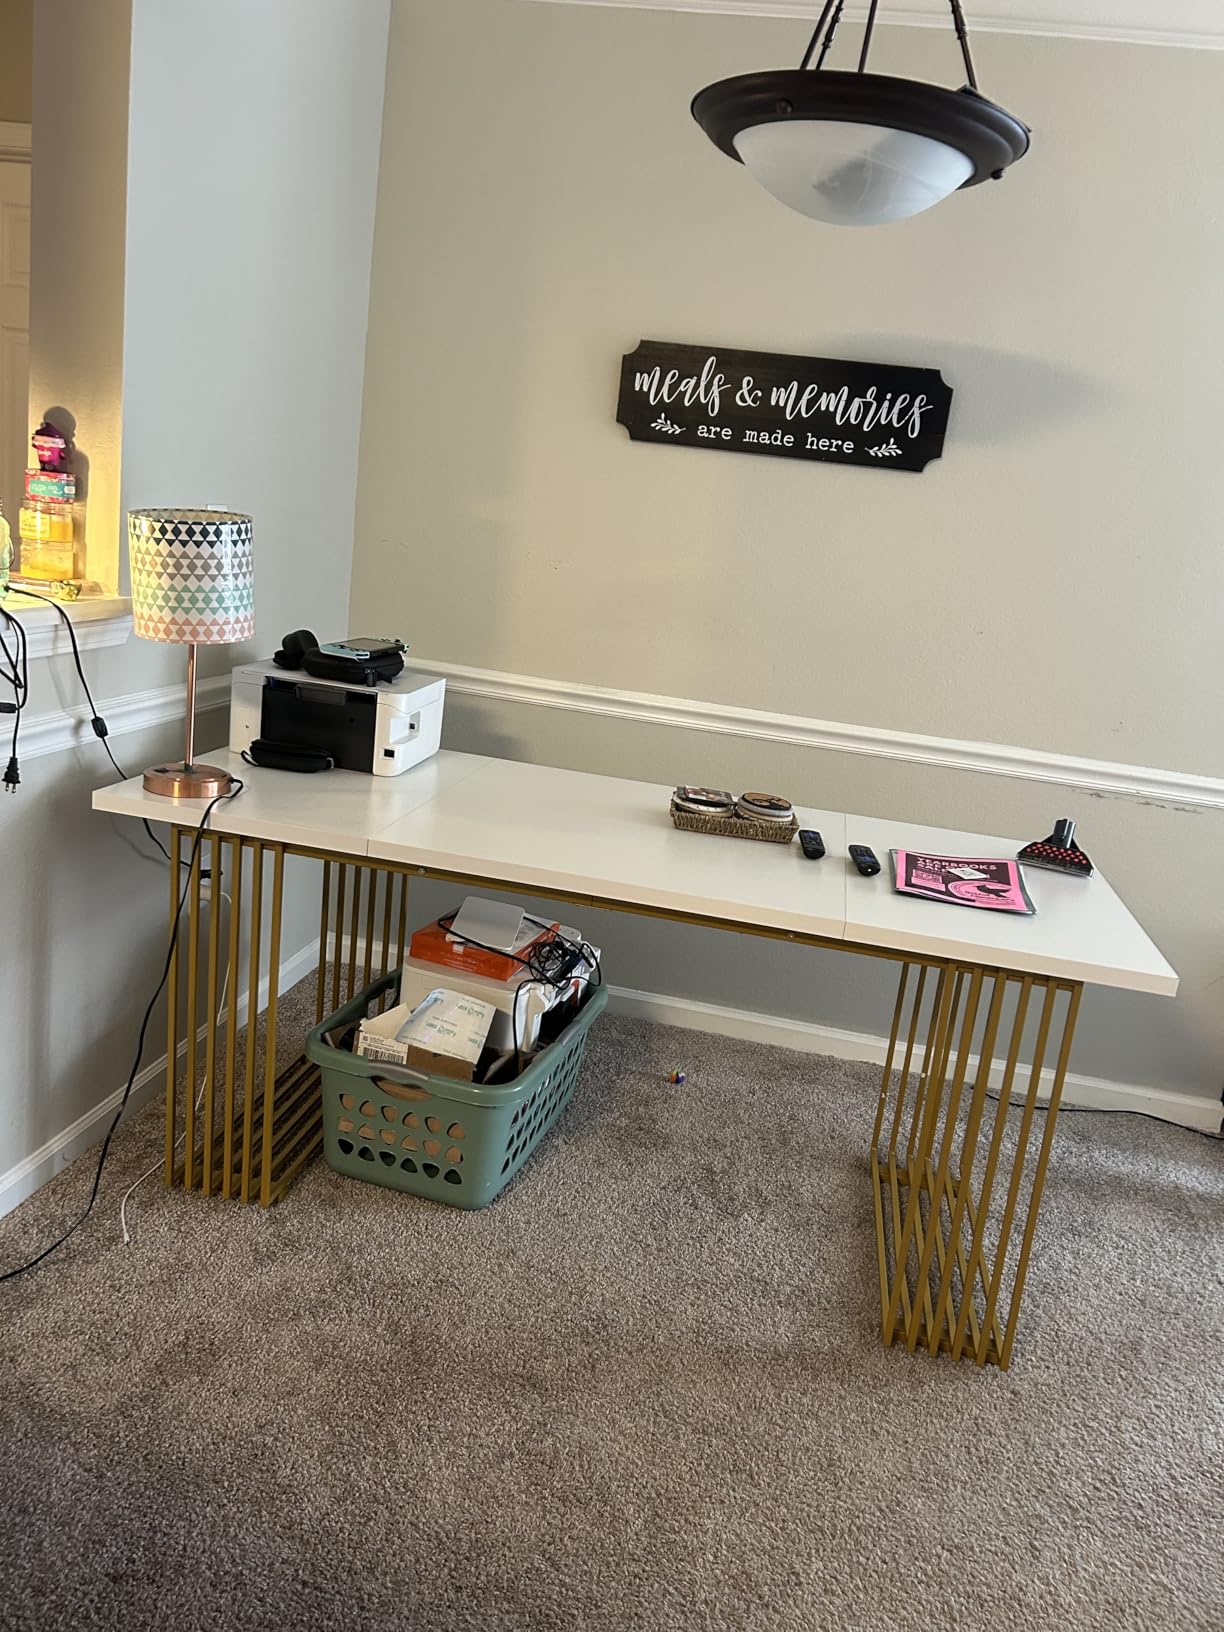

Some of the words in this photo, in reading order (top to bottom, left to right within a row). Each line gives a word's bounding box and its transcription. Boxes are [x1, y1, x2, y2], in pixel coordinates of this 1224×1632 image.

[634, 355, 732, 417] meals
[735, 375, 763, 408] &
[770, 380, 934, 439] memories
[697, 424, 733, 440] are
[742, 429, 795, 447] made
[805, 432, 855, 453] here
[917, 857, 998, 871] YEARBOOKS
